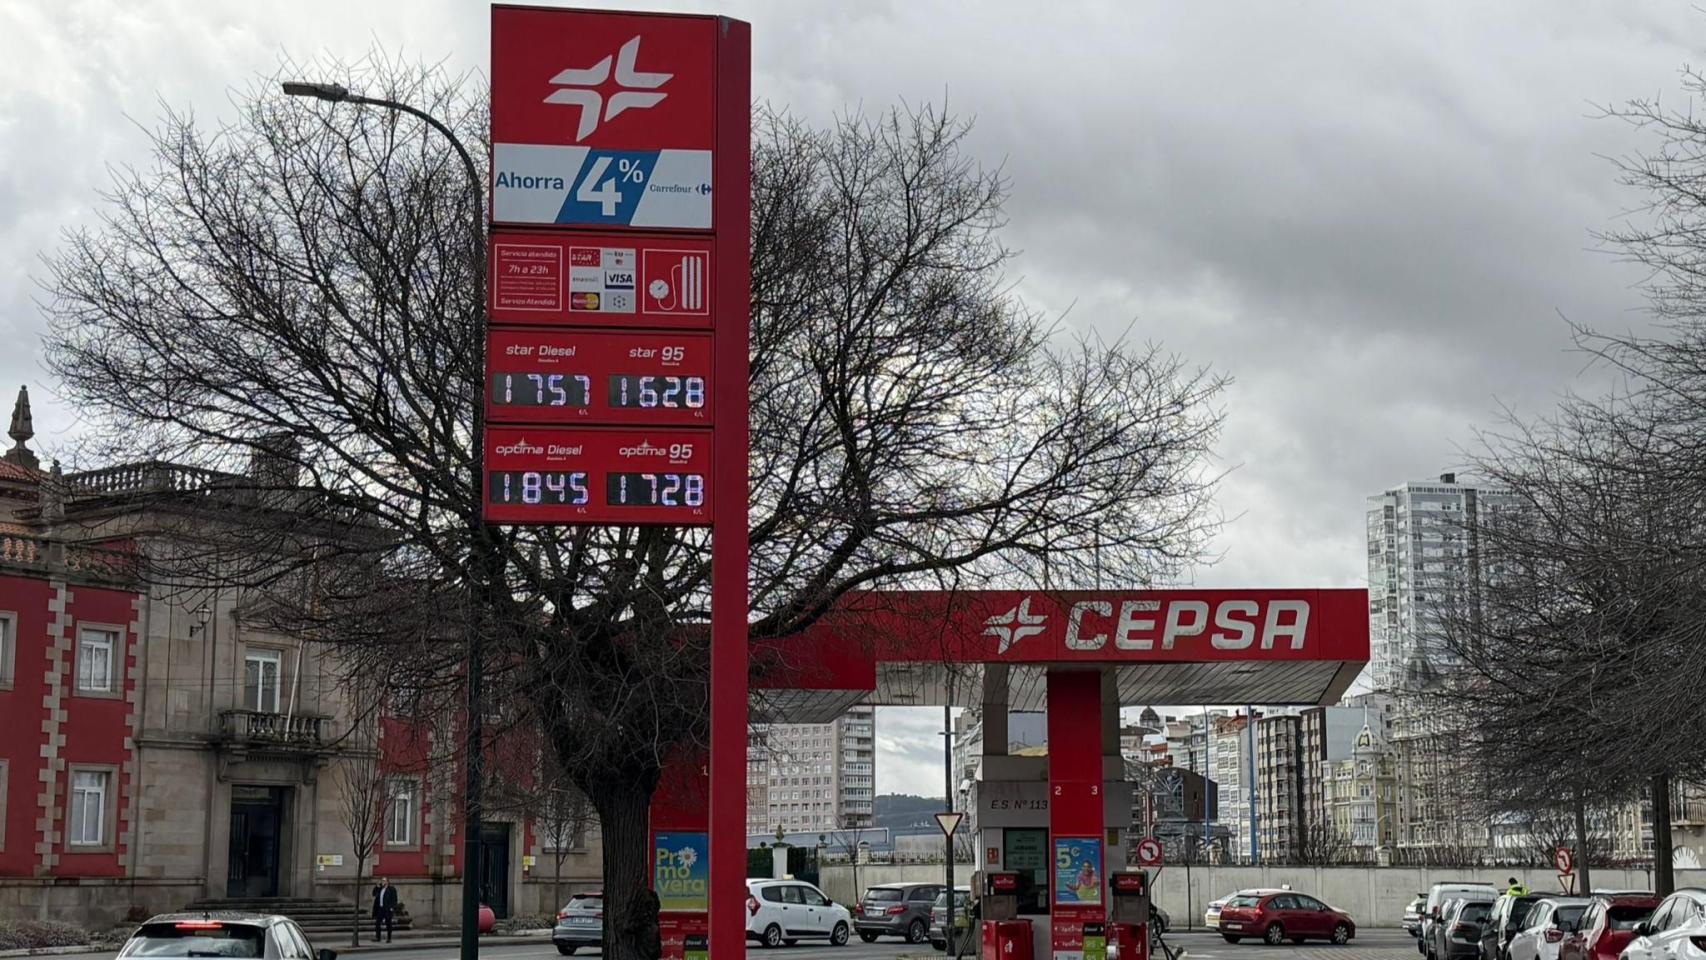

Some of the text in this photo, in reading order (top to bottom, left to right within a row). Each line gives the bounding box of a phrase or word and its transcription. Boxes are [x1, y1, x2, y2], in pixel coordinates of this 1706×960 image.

[495, 172, 564, 190] Ahorra
[650, 184, 691, 194] Carrefour
[508, 264, 520, 274] 7h
[530, 265, 549, 275] 23h
[609, 273, 633, 284] VISA
[506, 345, 576, 356] star Diesel
[629, 347, 684, 361] star 95
[495, 441, 583, 456] optima Diesel
[618, 442, 693, 459] optima 95
[1065, 600, 1310, 650] CEPSA
[1055, 786, 1062, 796] 2
[1091, 785, 1098, 795] 3
[657, 879, 705, 892] vera
